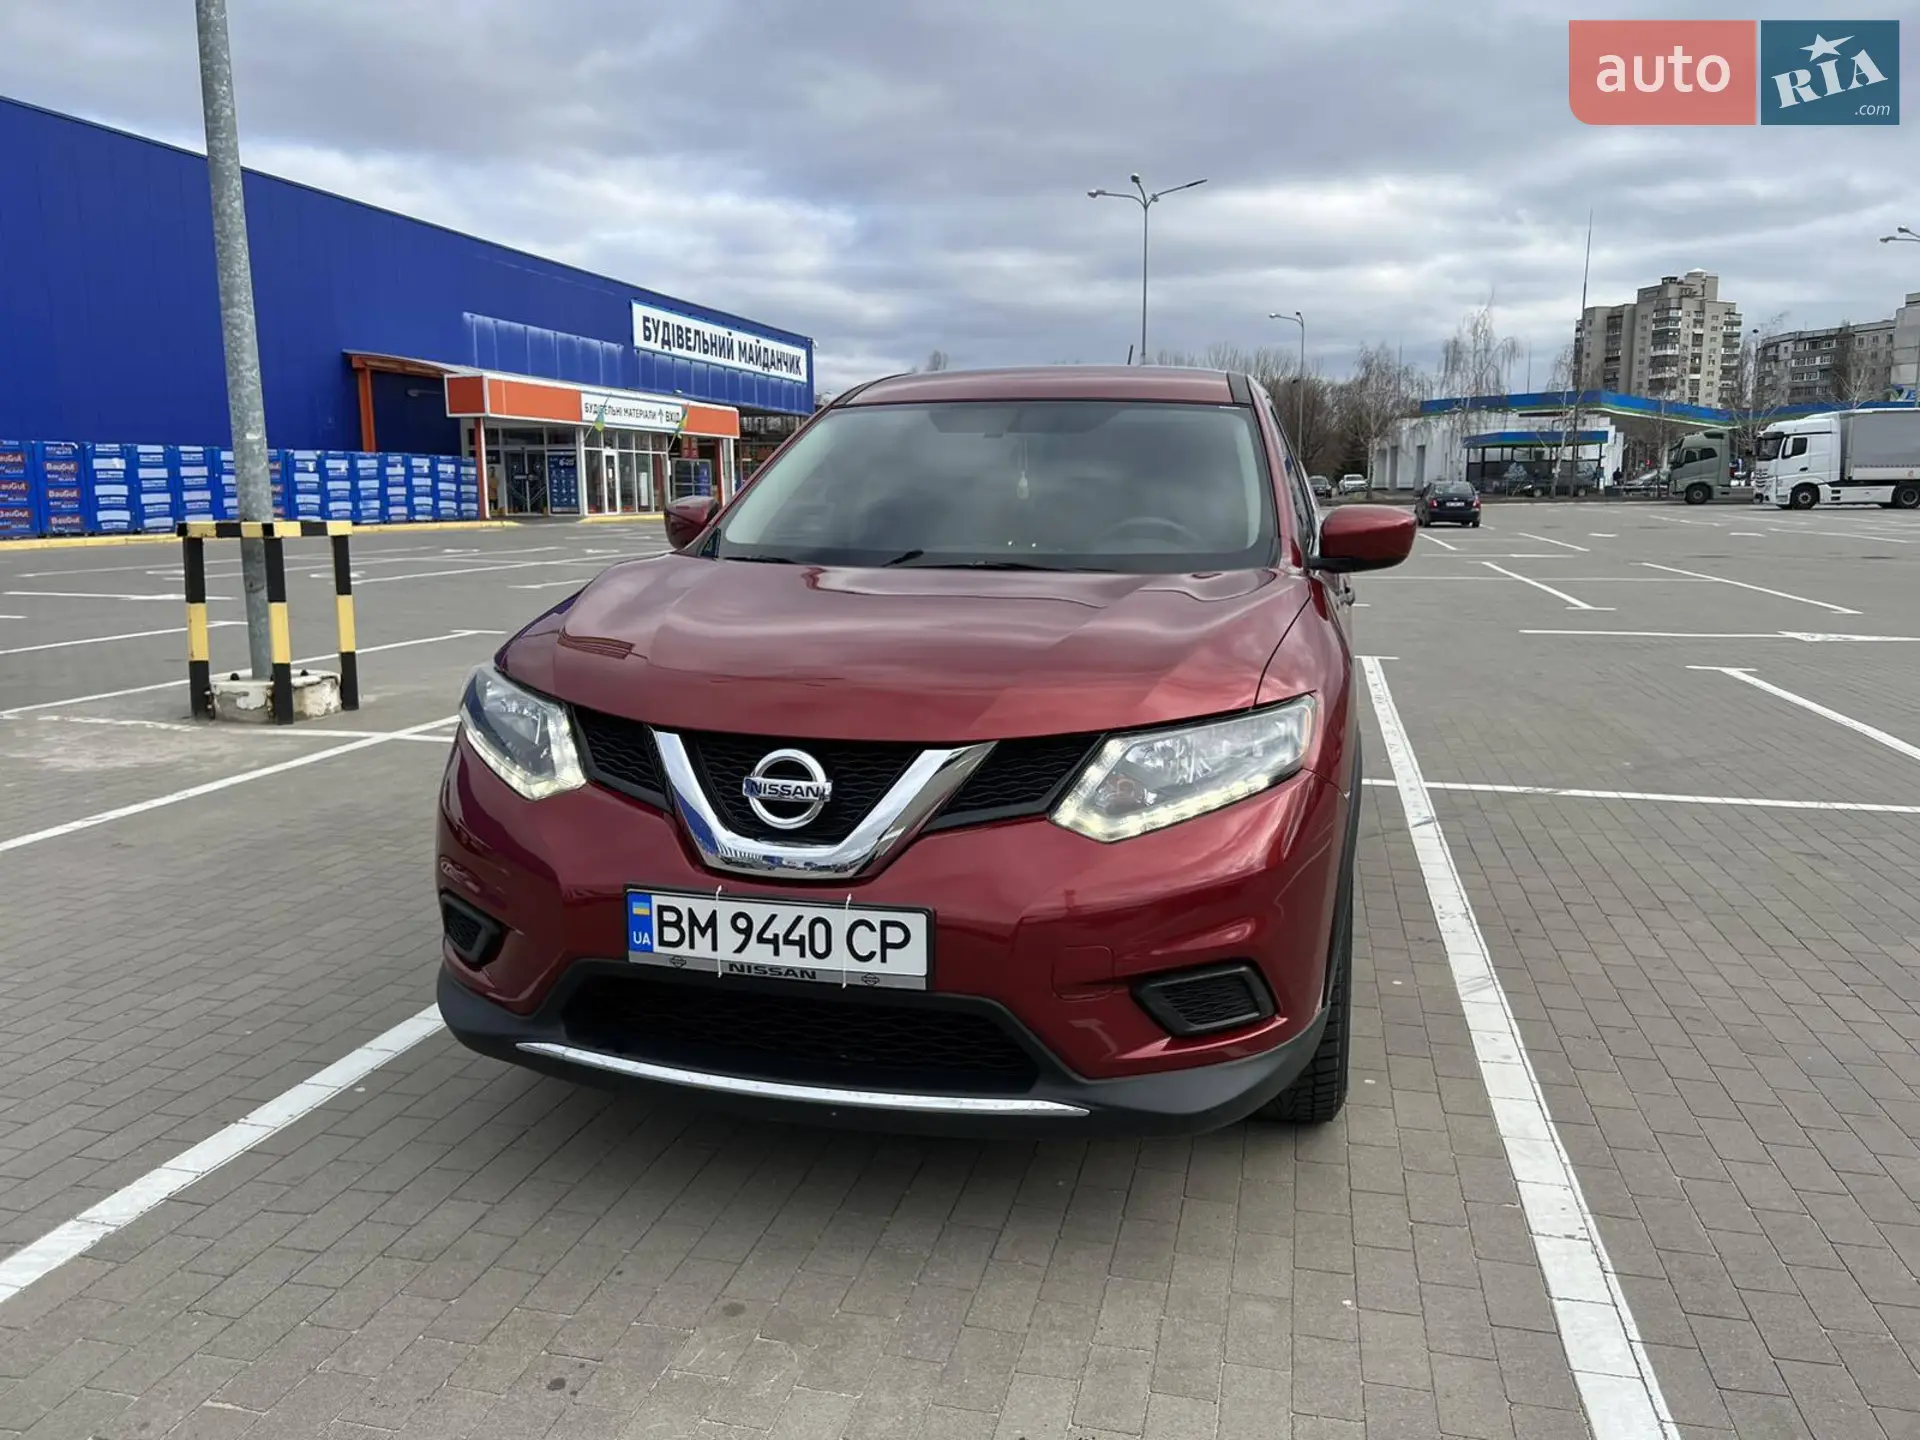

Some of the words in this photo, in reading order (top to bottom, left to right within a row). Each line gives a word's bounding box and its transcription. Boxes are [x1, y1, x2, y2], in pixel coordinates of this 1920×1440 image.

[642, 315, 735, 361] БУДІВЕЛЬНИЙ
[737, 339, 803, 377] МАЙДАНЧИК
[623, 407, 658, 421] МАТЕРІАЛИ
[750, 781, 821, 798] NISSAN
[633, 931, 652, 946] UA
[657, 904, 719, 952] BM
[730, 911, 833, 960] 9440
[846, 918, 912, 964] CP
[728, 963, 817, 980] NISSAN
